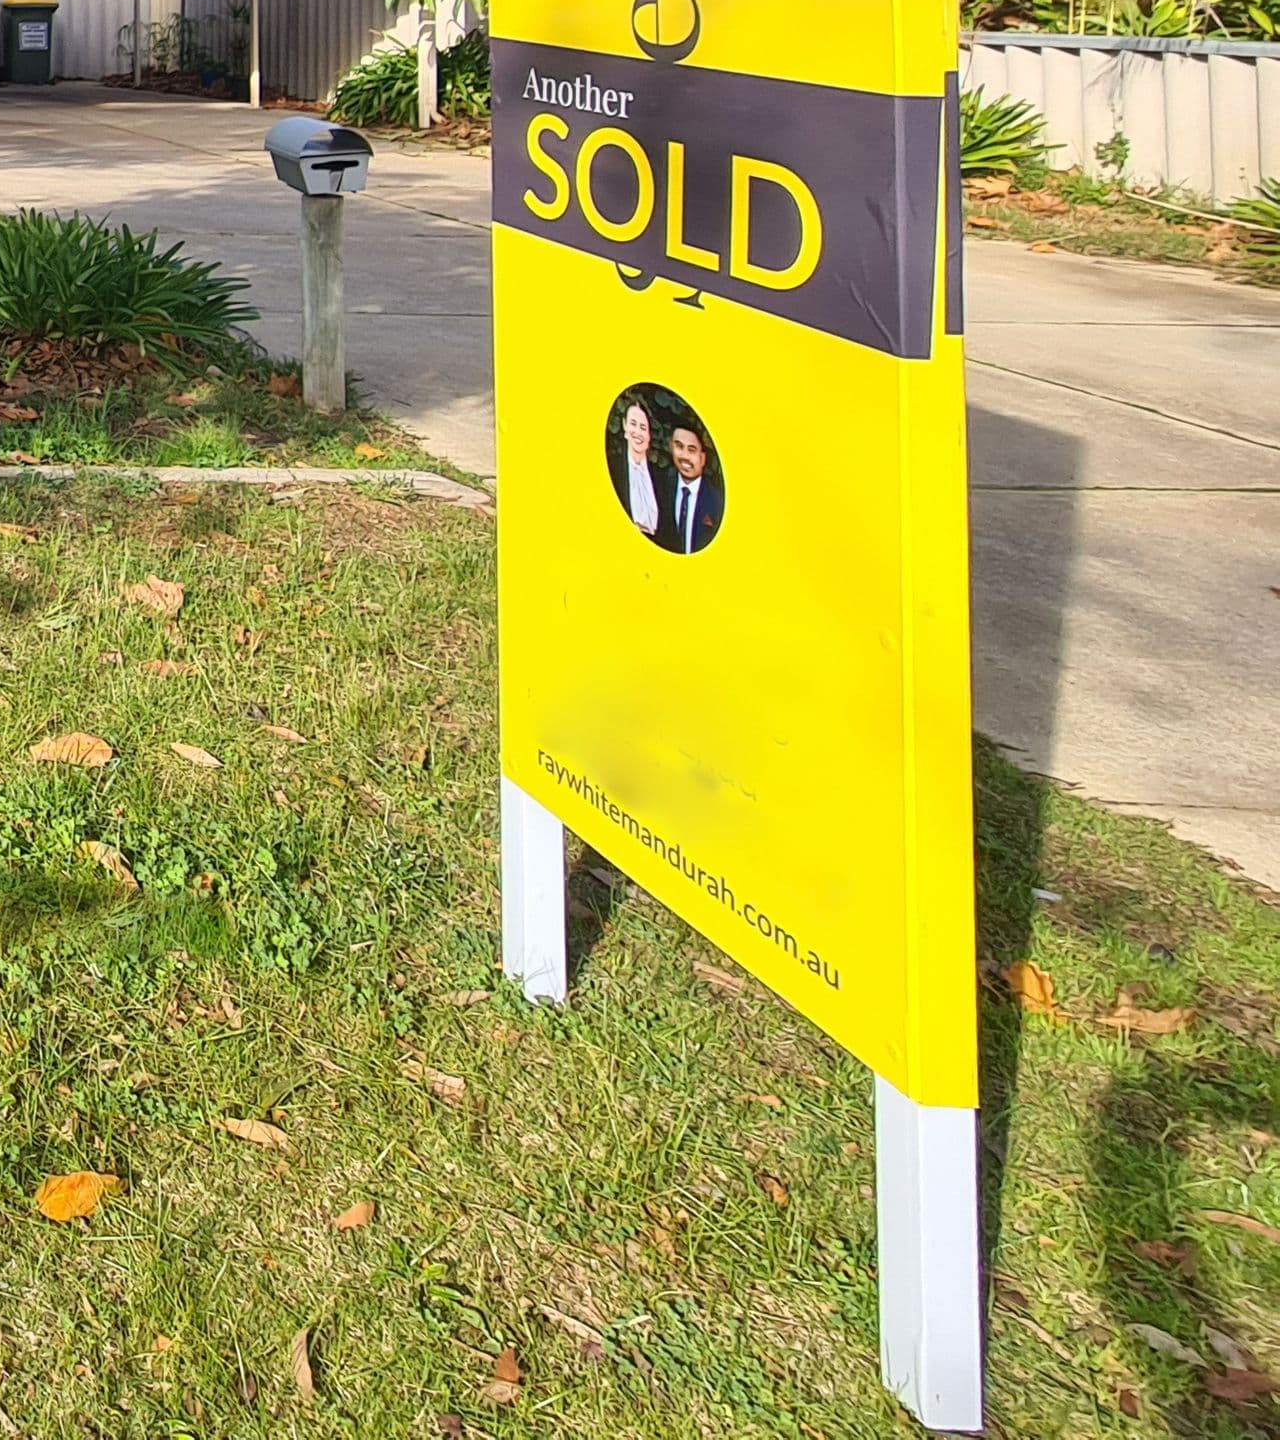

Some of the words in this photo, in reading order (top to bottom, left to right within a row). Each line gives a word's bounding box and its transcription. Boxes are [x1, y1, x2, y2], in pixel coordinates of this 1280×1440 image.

[522, 67, 634, 118] Another
[523, 113, 823, 291] SOLD
[538, 748, 840, 991] raywhitemandurah.com.au
